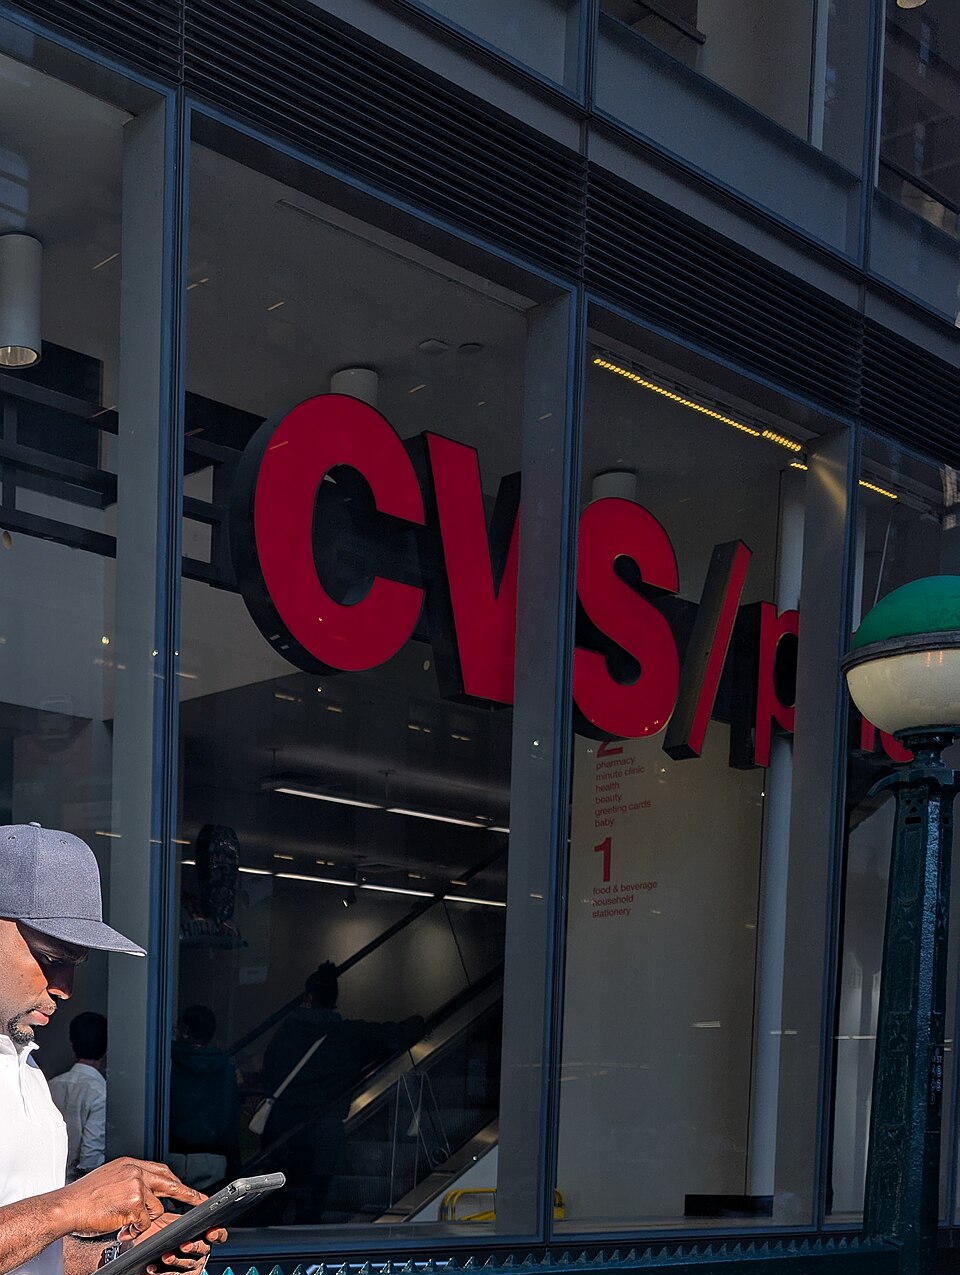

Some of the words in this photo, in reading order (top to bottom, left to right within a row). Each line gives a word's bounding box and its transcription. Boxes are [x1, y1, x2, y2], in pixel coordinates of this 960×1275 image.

[254, 393, 914, 768] CVS/p
[596, 756, 635, 771] pharmacy
[596, 769, 623, 781] minute
[625, 765, 645, 777] clinic
[595, 782, 620, 793] health
[595, 793, 623, 805] beauty
[594, 804, 627, 817] greeting
[628, 800, 651, 811] cards
[594, 817, 615, 828] baby
[594, 837, 612, 883] 1
[593, 884, 611, 895] food
[613, 883, 619, 893] &
[620, 881, 657, 892] beverage
[592, 895, 634, 907] household
[592, 906, 631, 918] stationery
